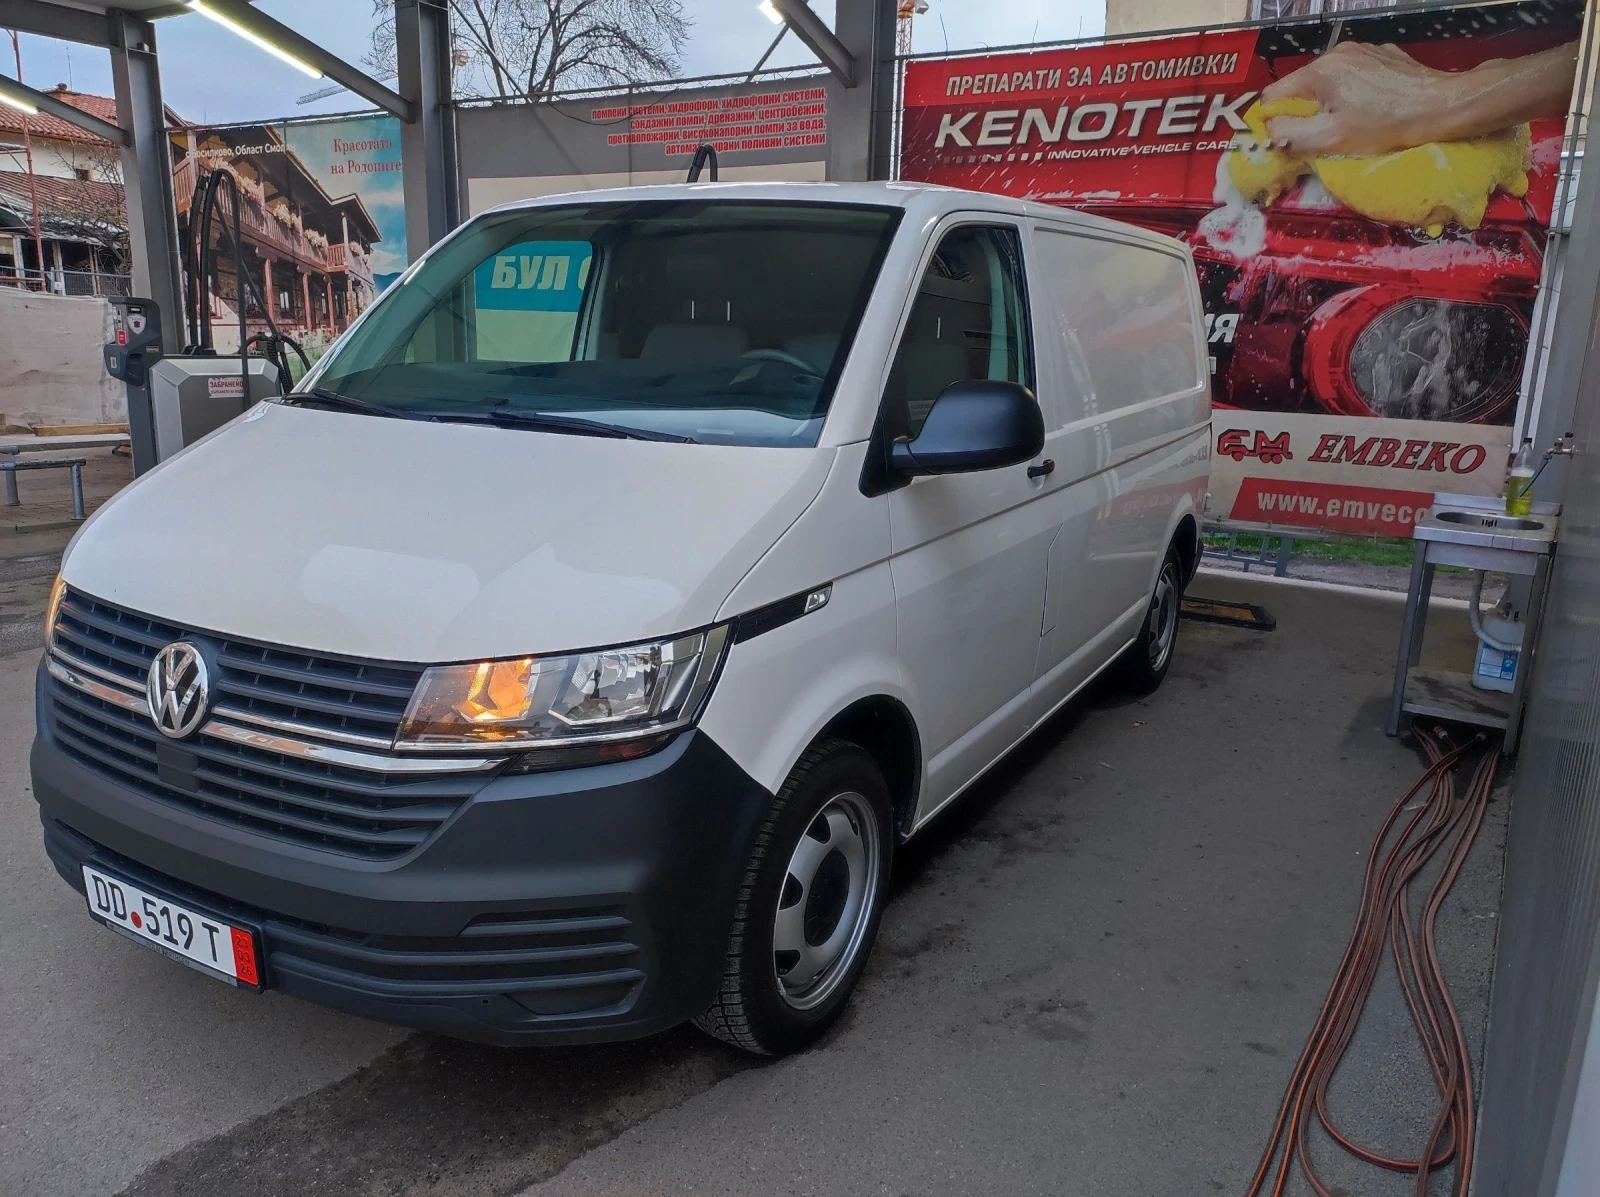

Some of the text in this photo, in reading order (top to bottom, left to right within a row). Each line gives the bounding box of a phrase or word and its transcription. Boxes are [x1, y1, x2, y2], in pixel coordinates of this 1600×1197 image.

[946, 52, 1240, 97] ПРЕПАРАТИ ЗА АВТОМИВКИ
[592, 107, 627, 120] помпени
[629, 104, 667, 116] системи,
[721, 93, 781, 109] хидрофорни
[783, 88, 827, 103] системи,
[630, 103, 826, 131] сондажни помпи, дренажни, центробежни,
[934, 90, 1260, 149] KENOTEK
[682, 125, 752, 140] високонапорни
[754, 122, 785, 135] помпи
[786, 119, 800, 131] за
[800, 118, 826, 131] вода,
[235, 143, 264, 156] Област
[332, 138, 392, 156] Красотата
[665, 133, 826, 156] автомаирани поливни системи
[1047, 140, 1239, 158] INNOVATIVE VEHICLE CARE
[330, 159, 402, 176] на Родопите
[491, 255, 570, 290] БУЛ
[209, 380, 243, 388] ЗАБРАНЕНО
[92, 874, 127, 920] DD
[142, 897, 194, 951] 519
[202, 921, 220, 963] T
[235, 935, 248, 948] 23
